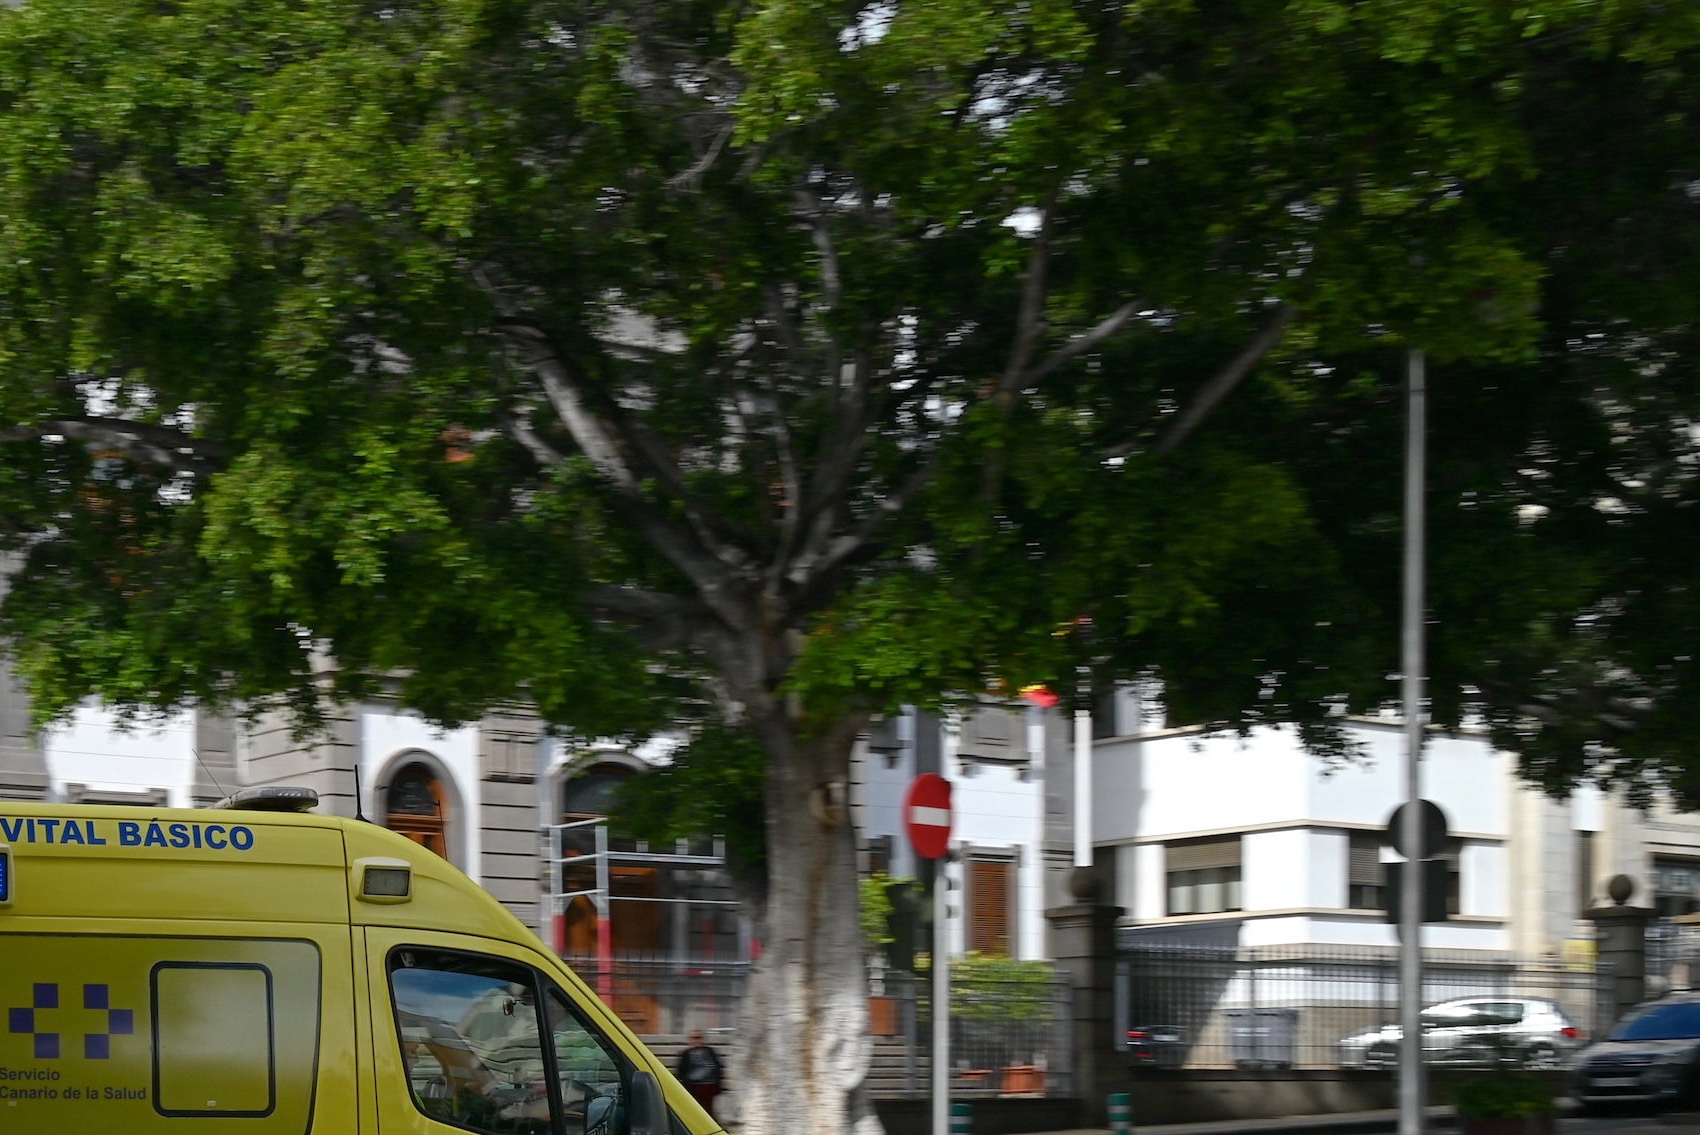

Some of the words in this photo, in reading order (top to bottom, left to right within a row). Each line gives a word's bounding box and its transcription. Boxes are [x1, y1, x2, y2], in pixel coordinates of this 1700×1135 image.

[0, 818, 107, 846] VITAL
[118, 818, 254, 851] BÁSICO
[63, 1085, 81, 1101] de
[85, 1085, 99, 1101] la
[103, 1085, 147, 1101] Salud
